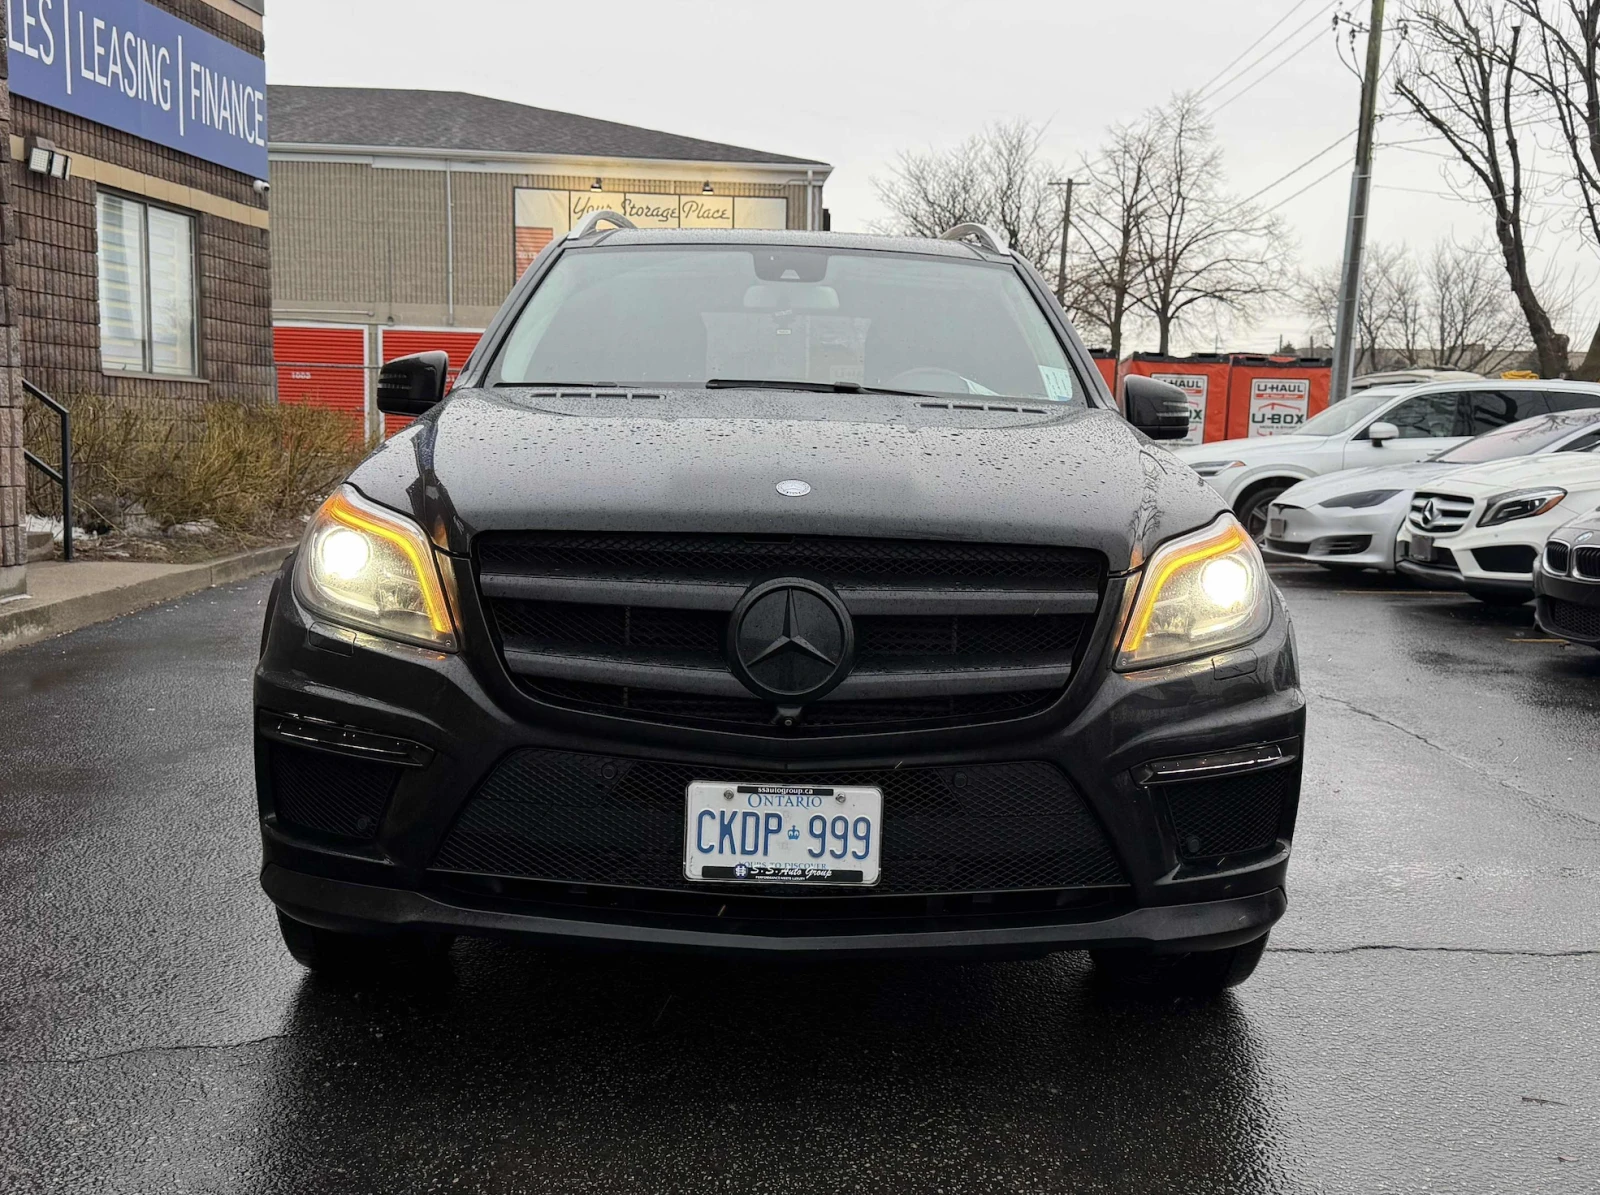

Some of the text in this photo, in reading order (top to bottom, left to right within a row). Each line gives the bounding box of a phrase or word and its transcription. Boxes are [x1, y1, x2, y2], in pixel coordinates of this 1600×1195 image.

[79, 11, 171, 111] LEASING
[190, 61, 265, 147] FINANCE
[621, 198, 679, 222] Storage
[682, 200, 730, 220] Place
[1163, 379, 1202, 389] -HAUL
[1257, 384, 1304, 392] U-HAUL
[1251, 413, 1305, 425] U-BOX
[757, 787, 814, 795] ssautogroup.ca
[696, 809, 871, 860] CKDP 999
[805, 867, 832, 879] Group
